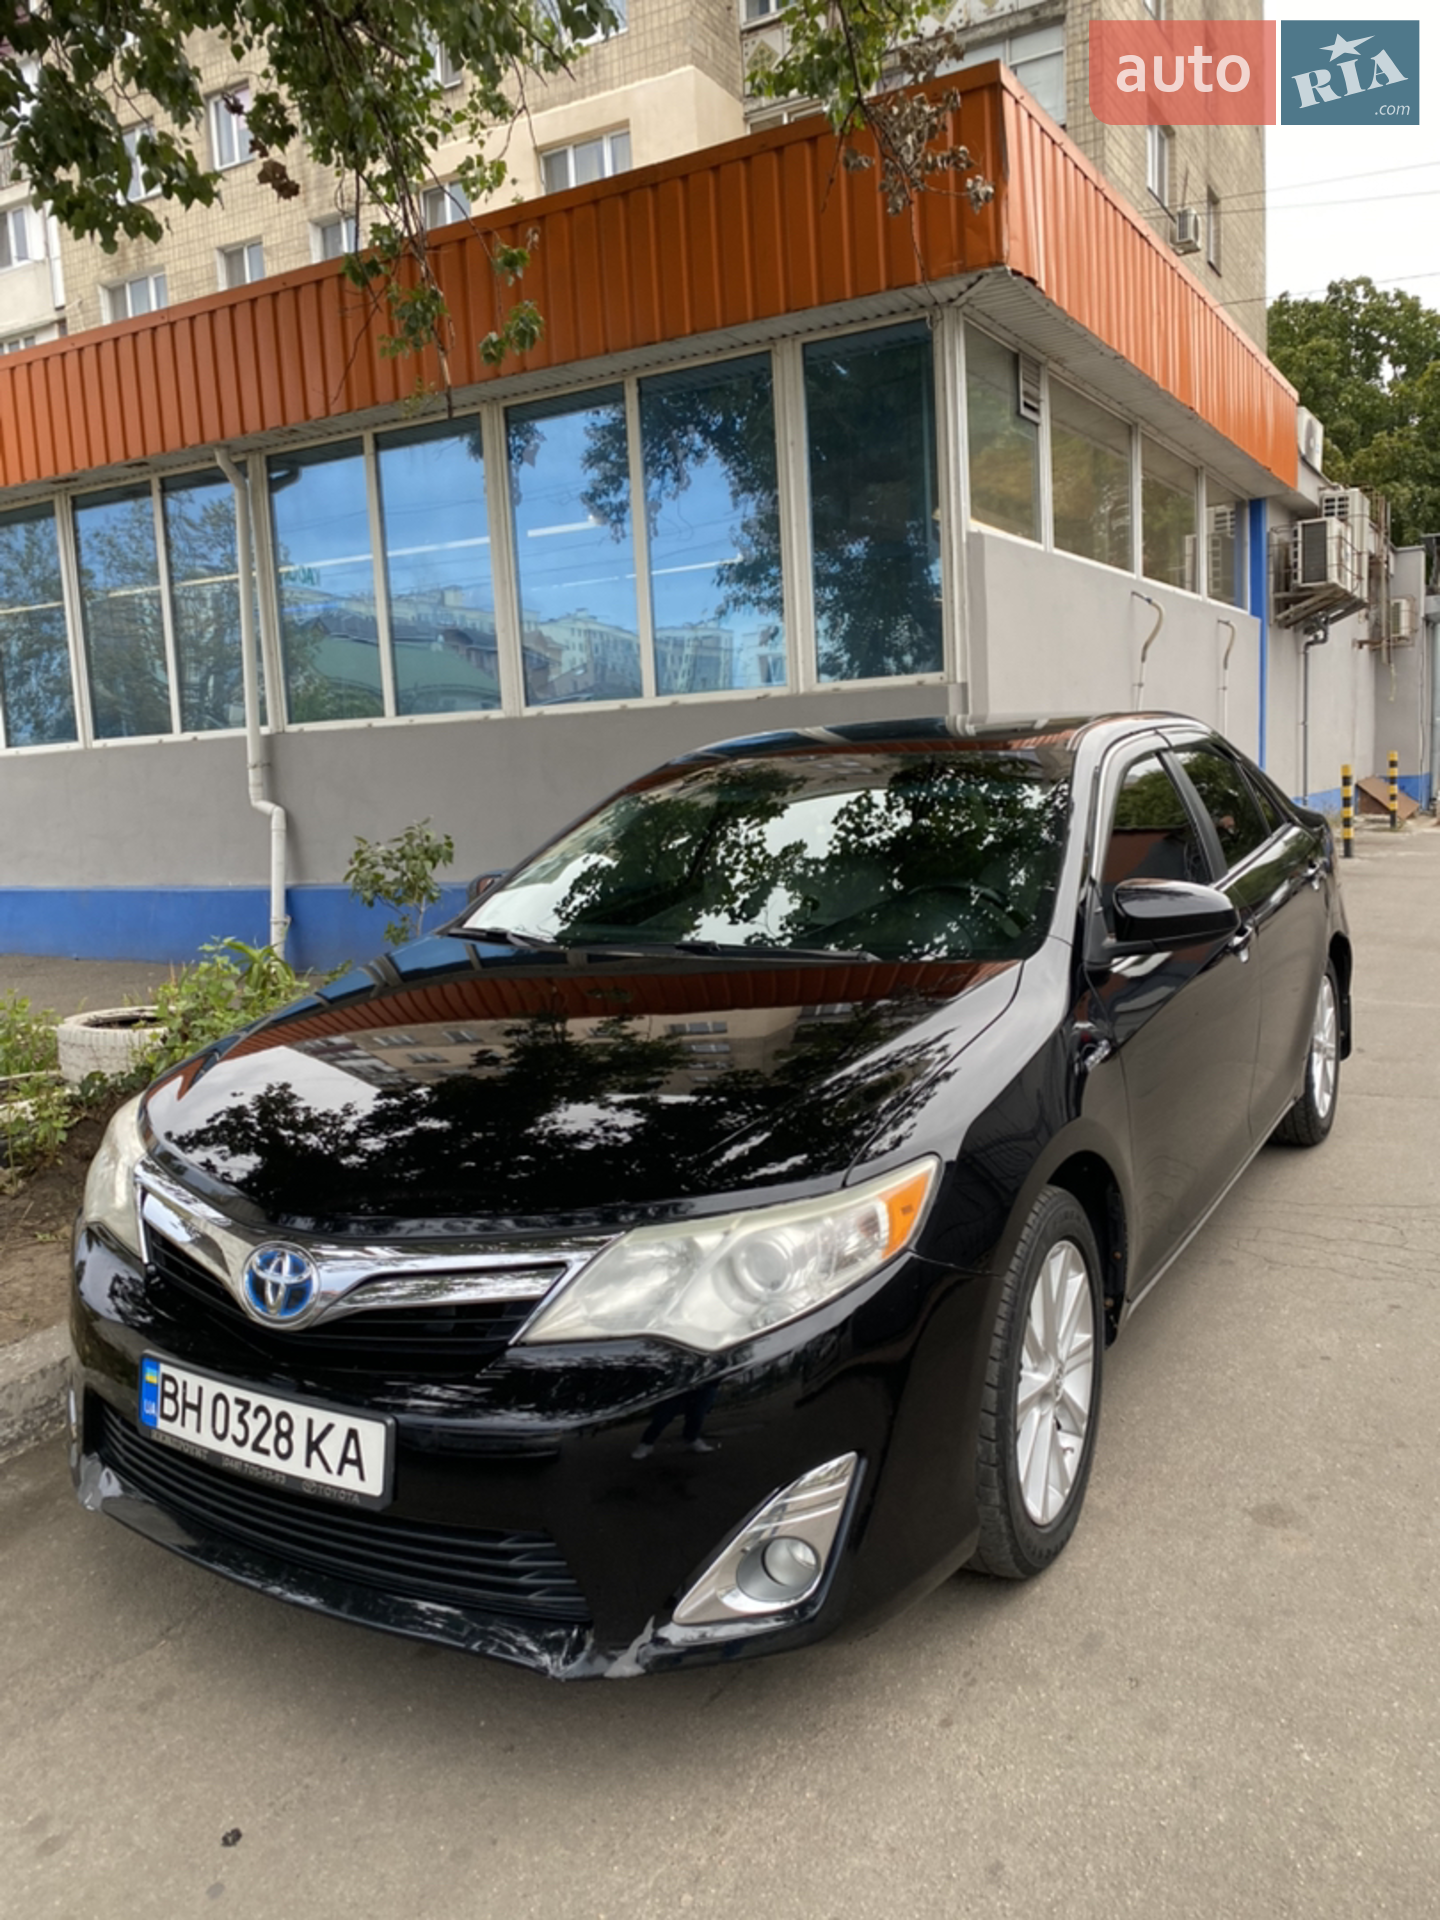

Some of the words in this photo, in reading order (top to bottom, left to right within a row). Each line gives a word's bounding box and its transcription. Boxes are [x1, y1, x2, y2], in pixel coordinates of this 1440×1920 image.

[159, 1371, 204, 1434] BH
[210, 1391, 295, 1462] 0328
[304, 1416, 366, 1483] KA
[317, 1484, 360, 1505] TOYOTA
